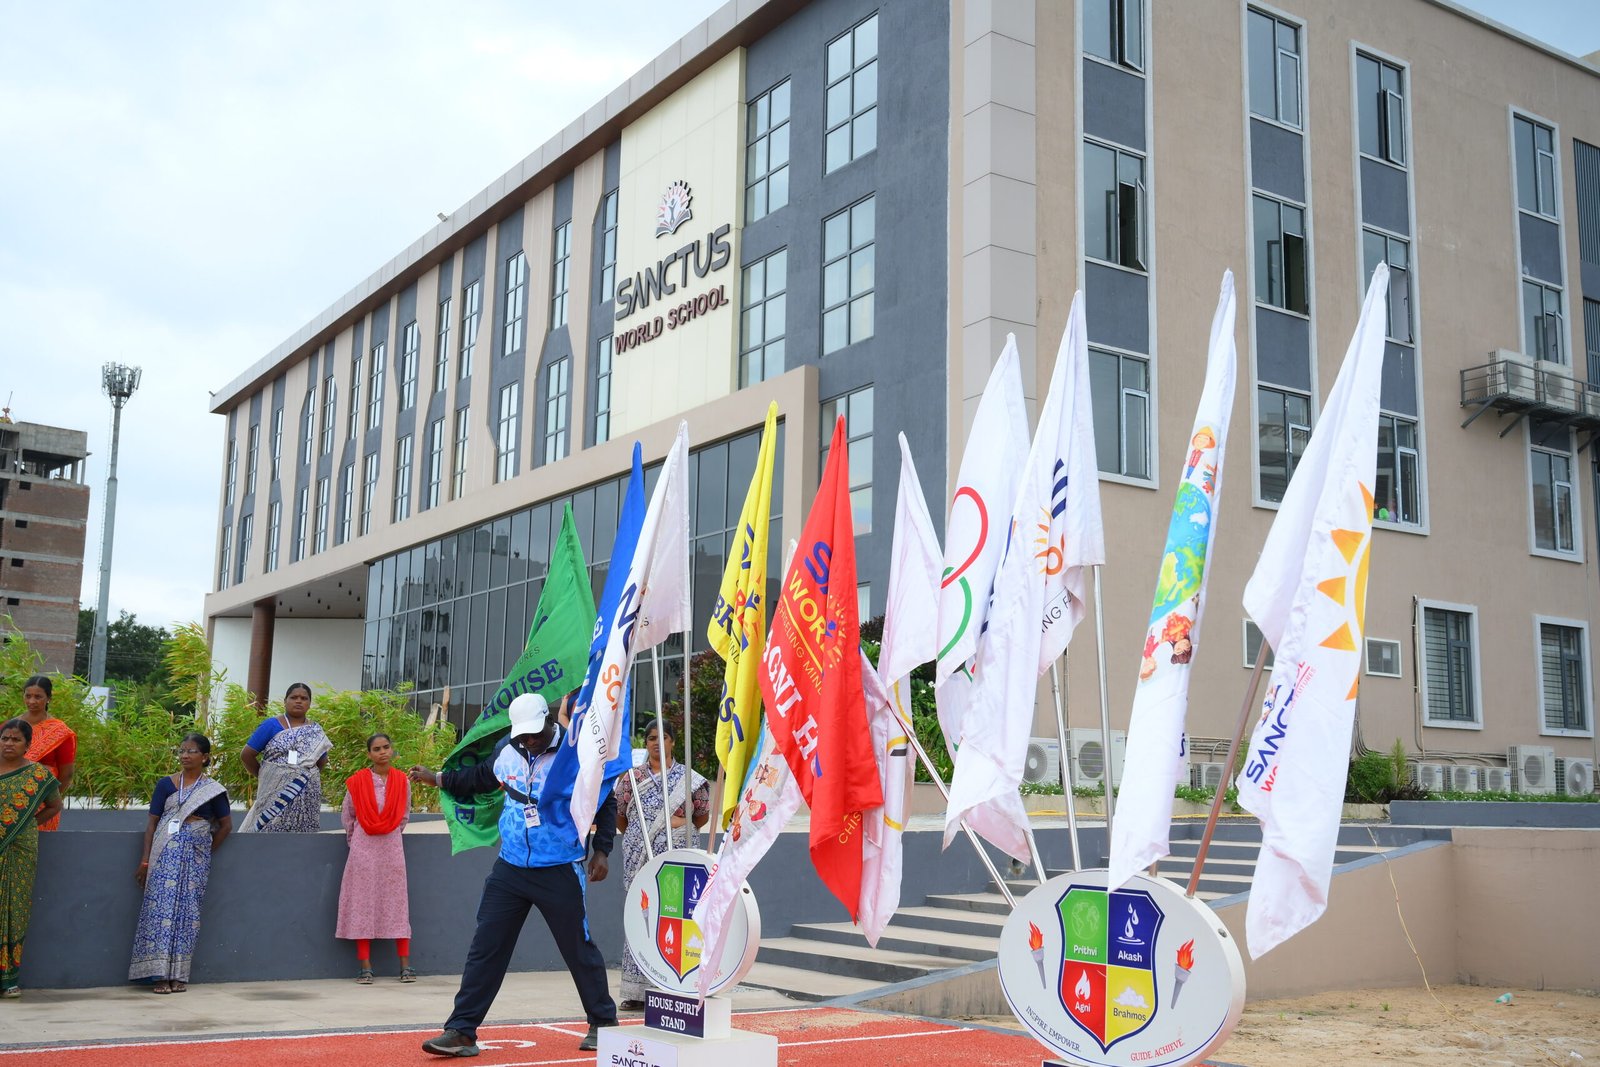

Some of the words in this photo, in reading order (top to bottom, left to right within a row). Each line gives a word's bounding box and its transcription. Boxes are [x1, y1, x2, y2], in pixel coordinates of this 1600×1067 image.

[615, 223, 731, 321] SANCTUS
[615, 315, 664, 355] WORLD
[667, 284, 729, 330] SCHOOL
[788, 569, 826, 653] WOR
[481, 657, 564, 721] HOUSE
[1073, 944, 1098, 957] Prithvi
[1117, 950, 1143, 963] Akash
[648, 995, 674, 1011] HOUSE
[674, 1000, 700, 1017] SPIRIT
[1074, 1001, 1091, 1013] Agni
[1113, 1007, 1147, 1022] Brahmos
[660, 1015, 686, 1032] STAND
[611, 1054, 661, 1067] SANCT
